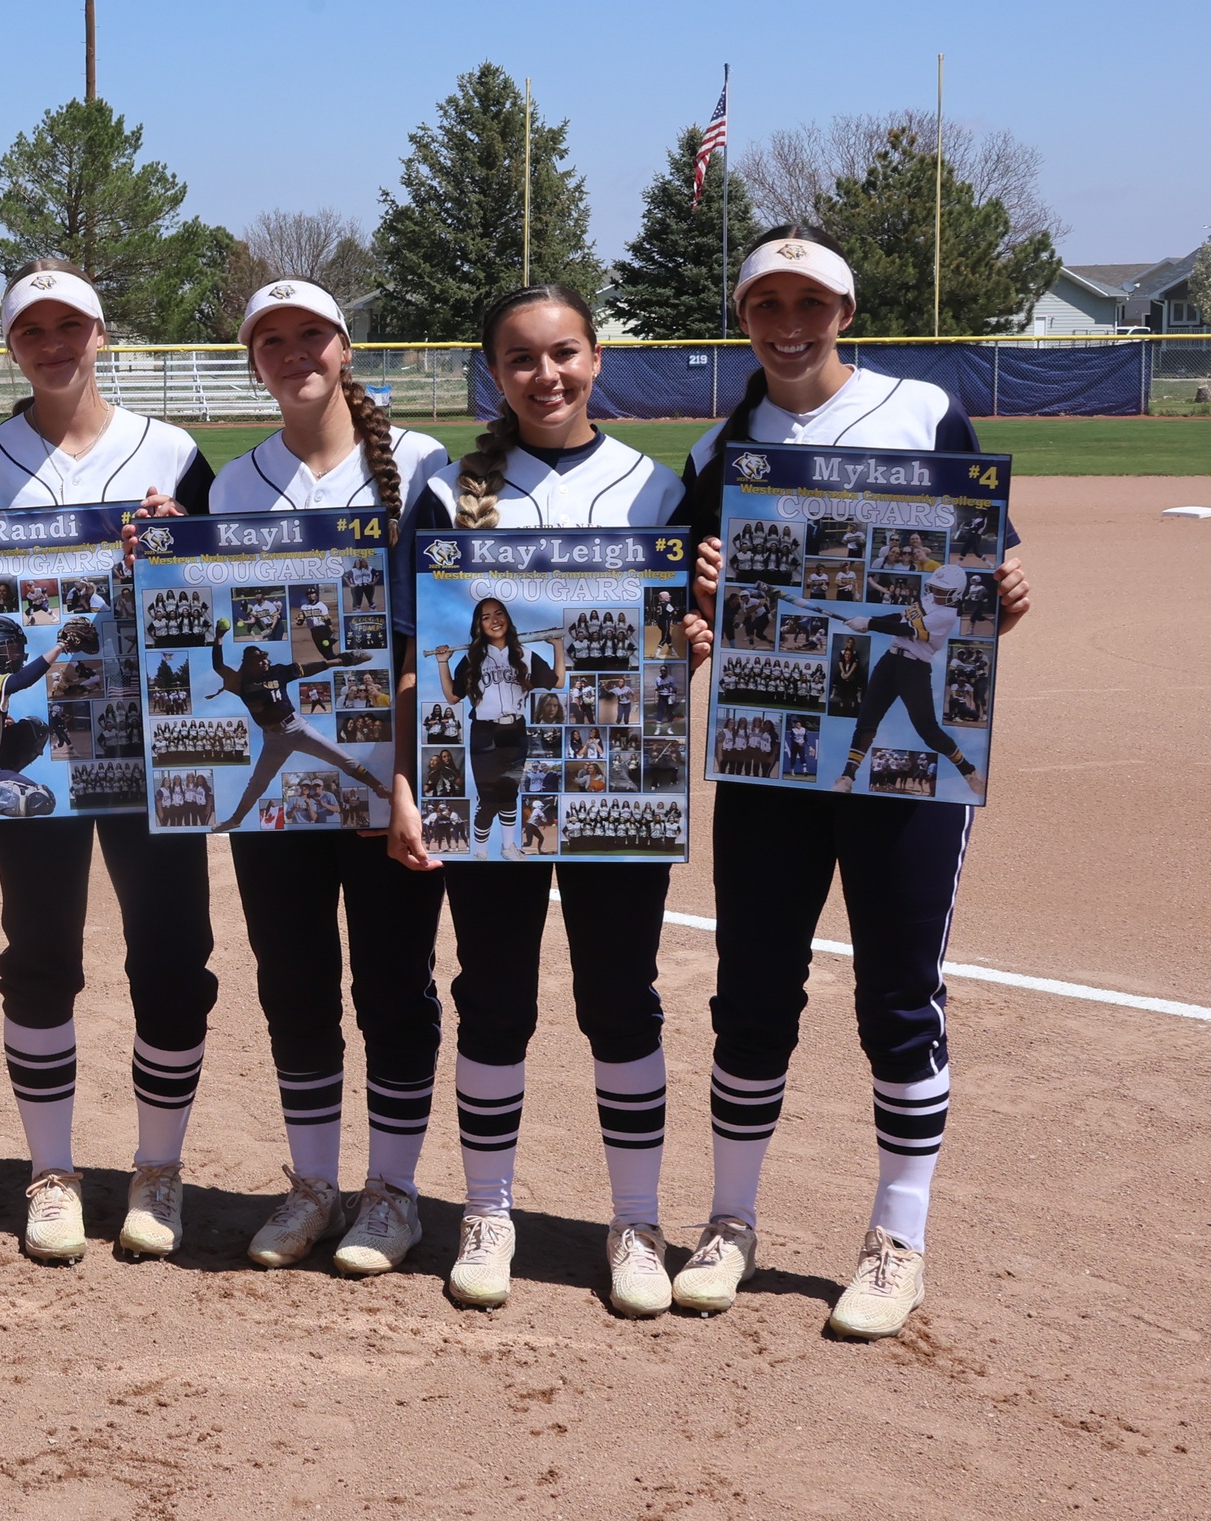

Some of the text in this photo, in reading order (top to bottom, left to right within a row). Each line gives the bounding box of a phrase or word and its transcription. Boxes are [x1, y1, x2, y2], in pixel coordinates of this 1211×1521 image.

[689, 355, 708, 365] 219
[813, 456, 999, 490] Mykah #4
[740, 483, 993, 510] Western Nebraska Community College
[777, 495, 957, 529] COUGARS
[217, 517, 383, 551] Kayli #14
[33, 543, 98, 556] Community
[100, 540, 123, 550] Coll
[148, 547, 376, 565] Western Nebraska Community College
[654, 538, 685, 562] #3
[183, 556, 346, 586] COUGARS
[432, 569, 676, 582] Western Nebraska Community College
[469, 576, 644, 602] COUGARS
[271, 689, 282, 703] 14
